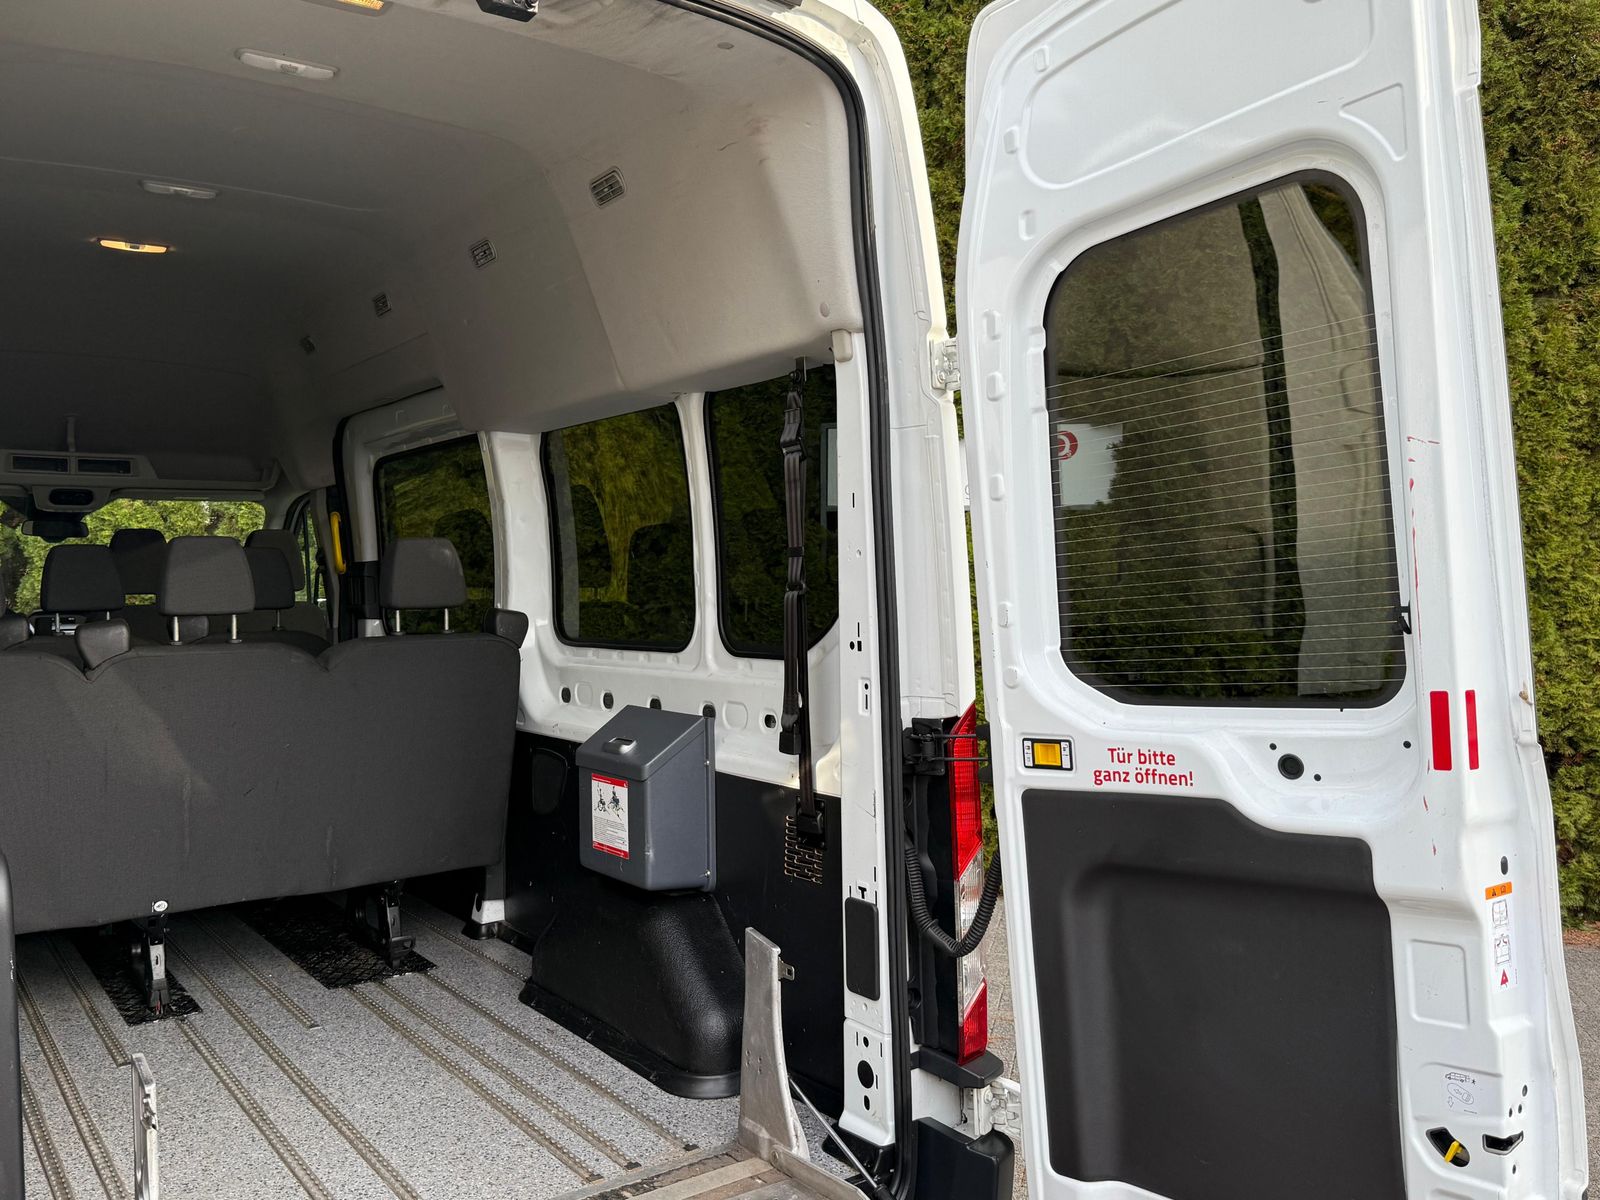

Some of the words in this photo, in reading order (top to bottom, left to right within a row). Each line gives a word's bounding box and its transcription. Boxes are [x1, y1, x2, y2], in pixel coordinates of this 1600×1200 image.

[1107, 747, 1133, 764] Tür
[1137, 748, 1176, 766] bitte
[1093, 769, 1130, 786] ganz
[1134, 767, 1194, 787] öffnen!
